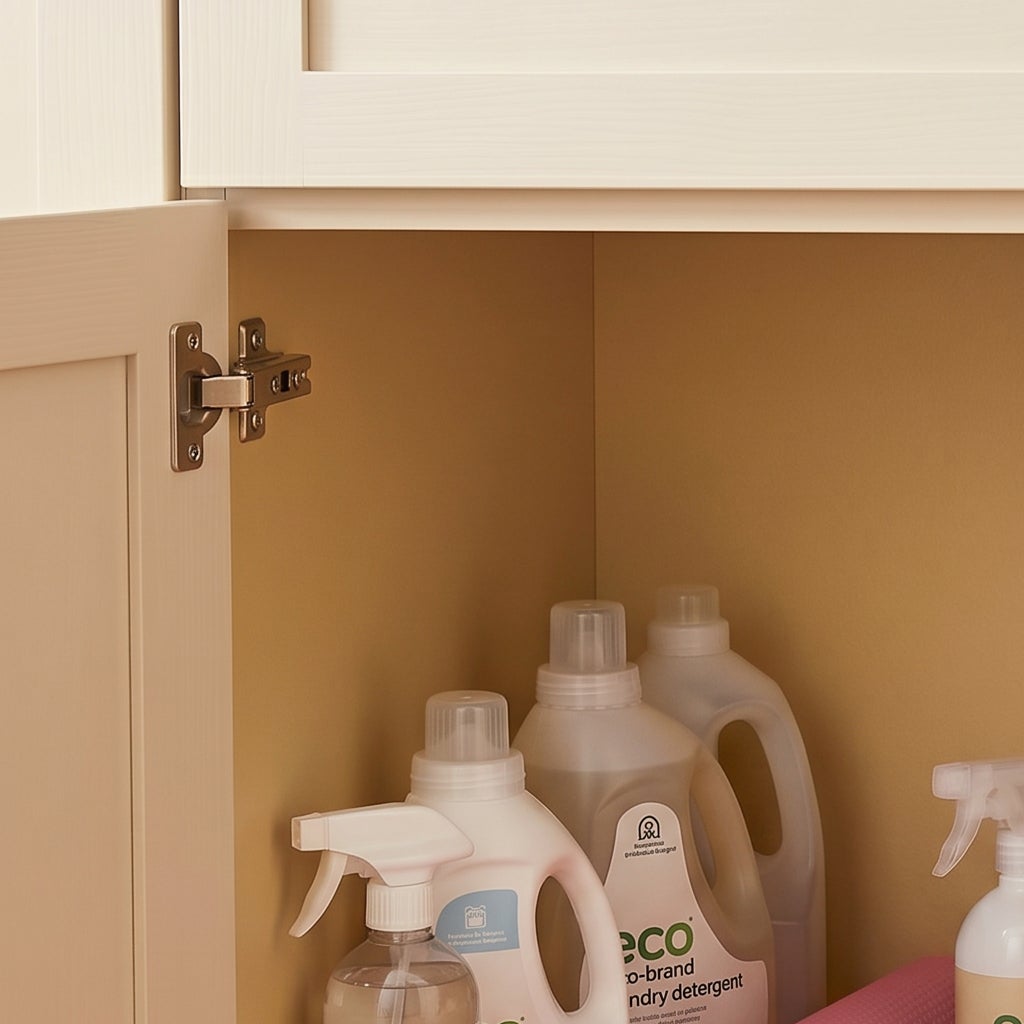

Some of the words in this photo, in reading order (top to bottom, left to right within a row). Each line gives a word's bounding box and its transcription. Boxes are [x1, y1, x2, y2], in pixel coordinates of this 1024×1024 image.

[625, 957, 695, 985] o-brand
[629, 988, 669, 1008] ndry
[671, 973, 744, 1001] detergent
